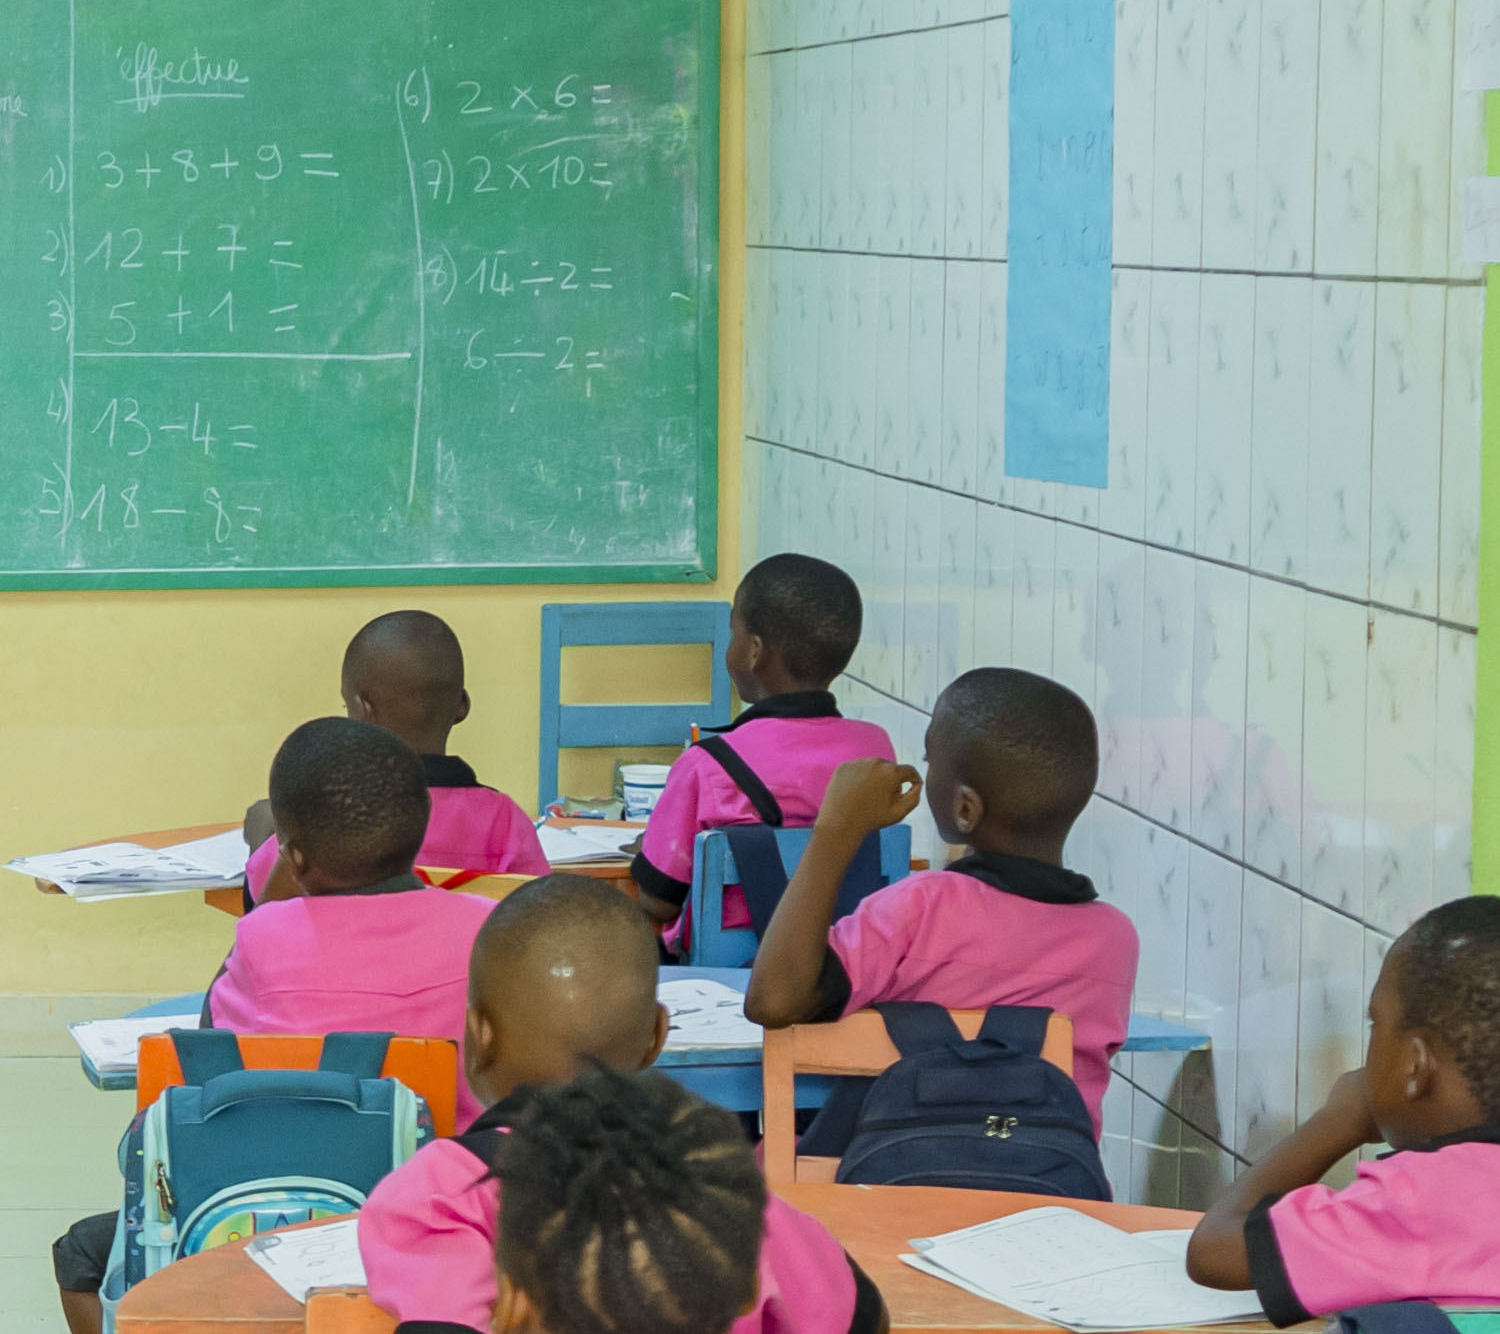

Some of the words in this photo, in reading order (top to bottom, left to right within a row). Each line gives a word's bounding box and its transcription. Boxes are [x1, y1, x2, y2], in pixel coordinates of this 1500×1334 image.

[457, 81, 493, 113] 2
[554, 74, 580, 108] 6
[84, 228, 144, 270] 12
[217, 224, 247, 271] 7
[105, 302, 136, 345] 5
[208, 291, 233, 332] 1
[92, 398, 151, 455] 13
